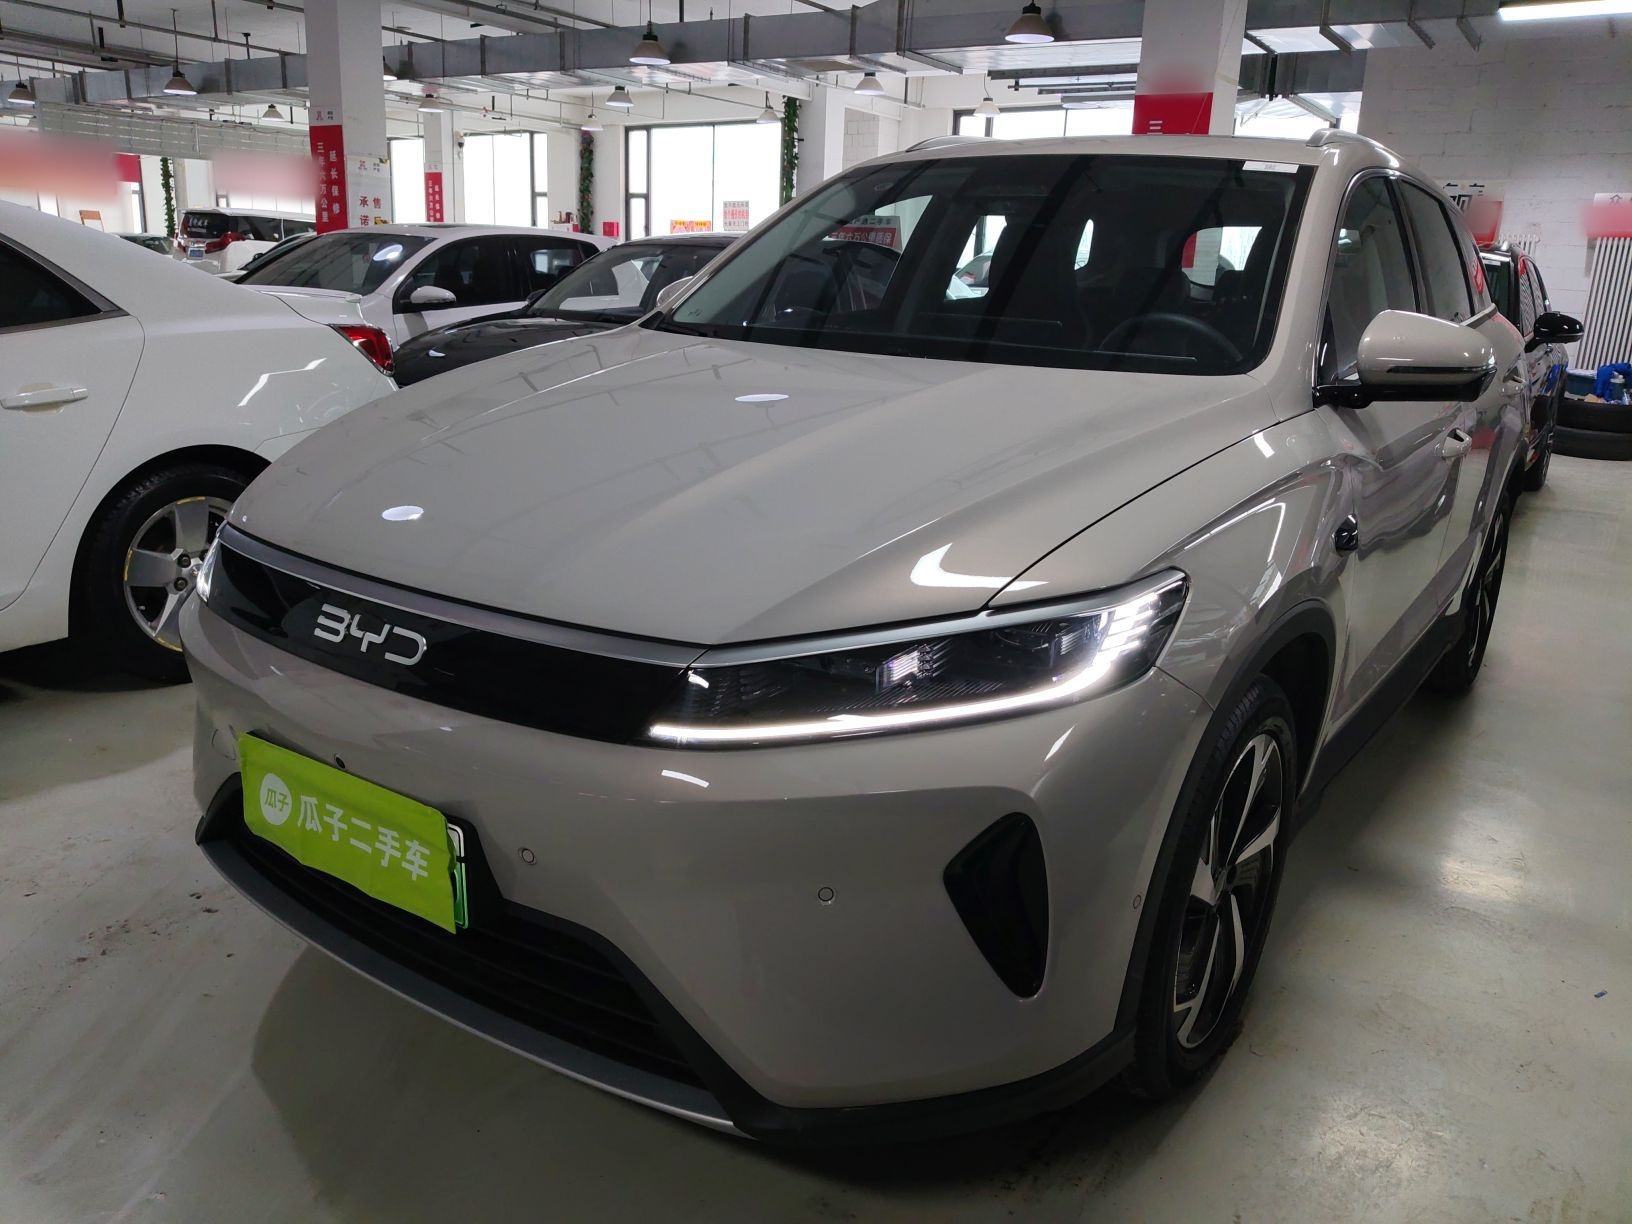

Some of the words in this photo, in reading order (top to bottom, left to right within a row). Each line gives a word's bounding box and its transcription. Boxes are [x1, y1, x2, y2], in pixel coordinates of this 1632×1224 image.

[317, 142, 329, 223] 三年六万公里
[329, 150, 340, 214] 延长保修
[359, 195, 370, 226] 承诺
[313, 602, 428, 666] BYD
[264, 787, 289, 812] 瓜子
[297, 793, 432, 881] 瓜子二手车
